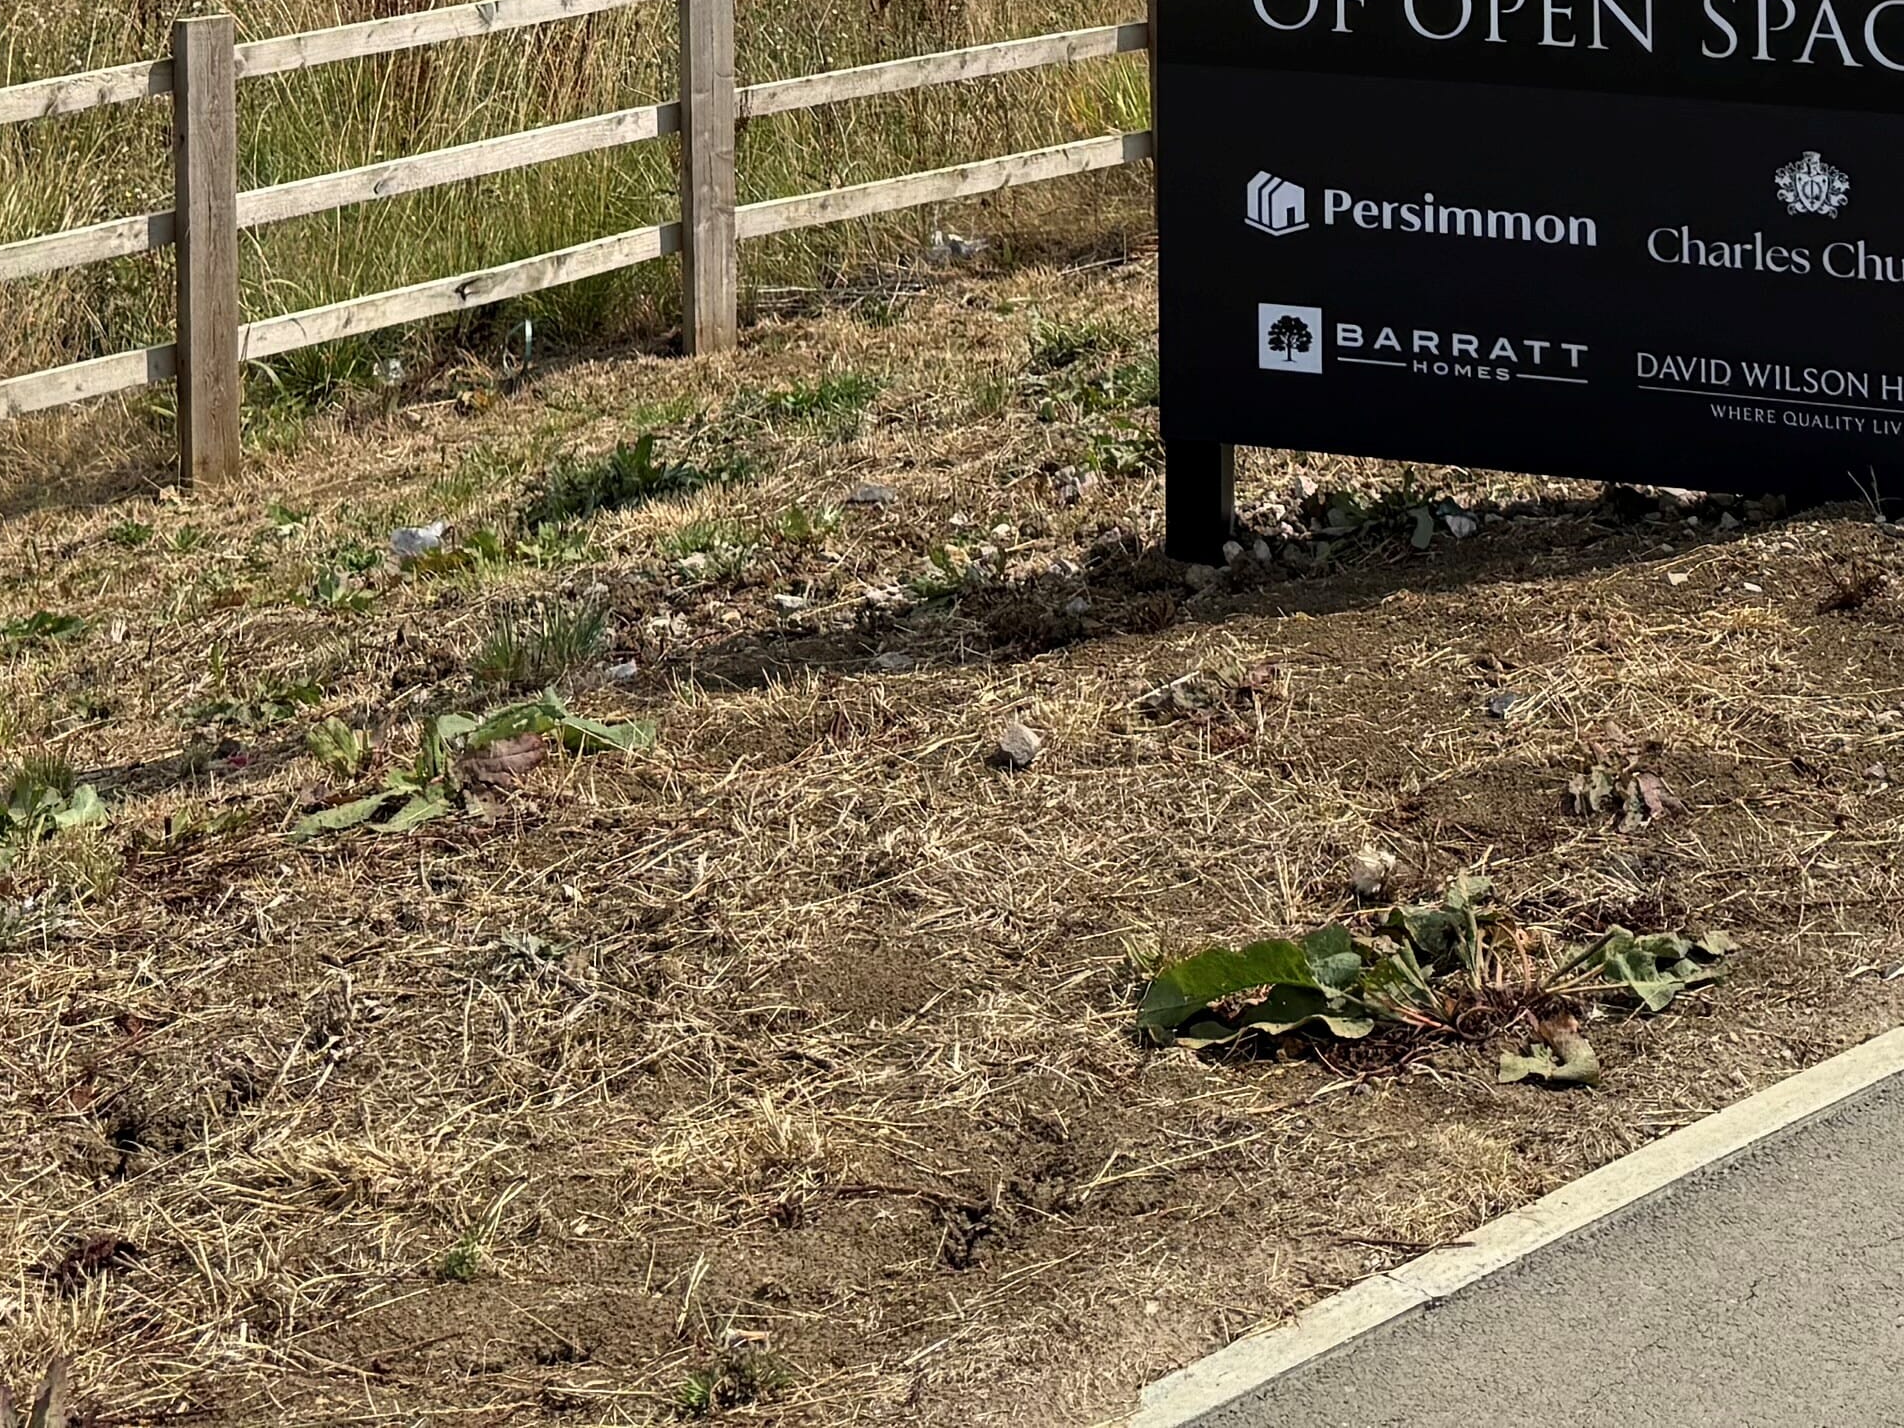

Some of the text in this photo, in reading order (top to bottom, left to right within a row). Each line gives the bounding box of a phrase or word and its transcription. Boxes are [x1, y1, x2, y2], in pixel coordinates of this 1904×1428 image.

[1324, 189, 1597, 246] Persimmon
[1647, 225, 1811, 274] Charles
[1336, 323, 1588, 368] BARRATT
[1411, 358, 1511, 382] HOMES
[1637, 352, 1732, 386] DAVID
[1740, 361, 1868, 399] WILSON
[1710, 401, 1779, 424] WHERE
[1781, 409, 1866, 434] QUALITY
